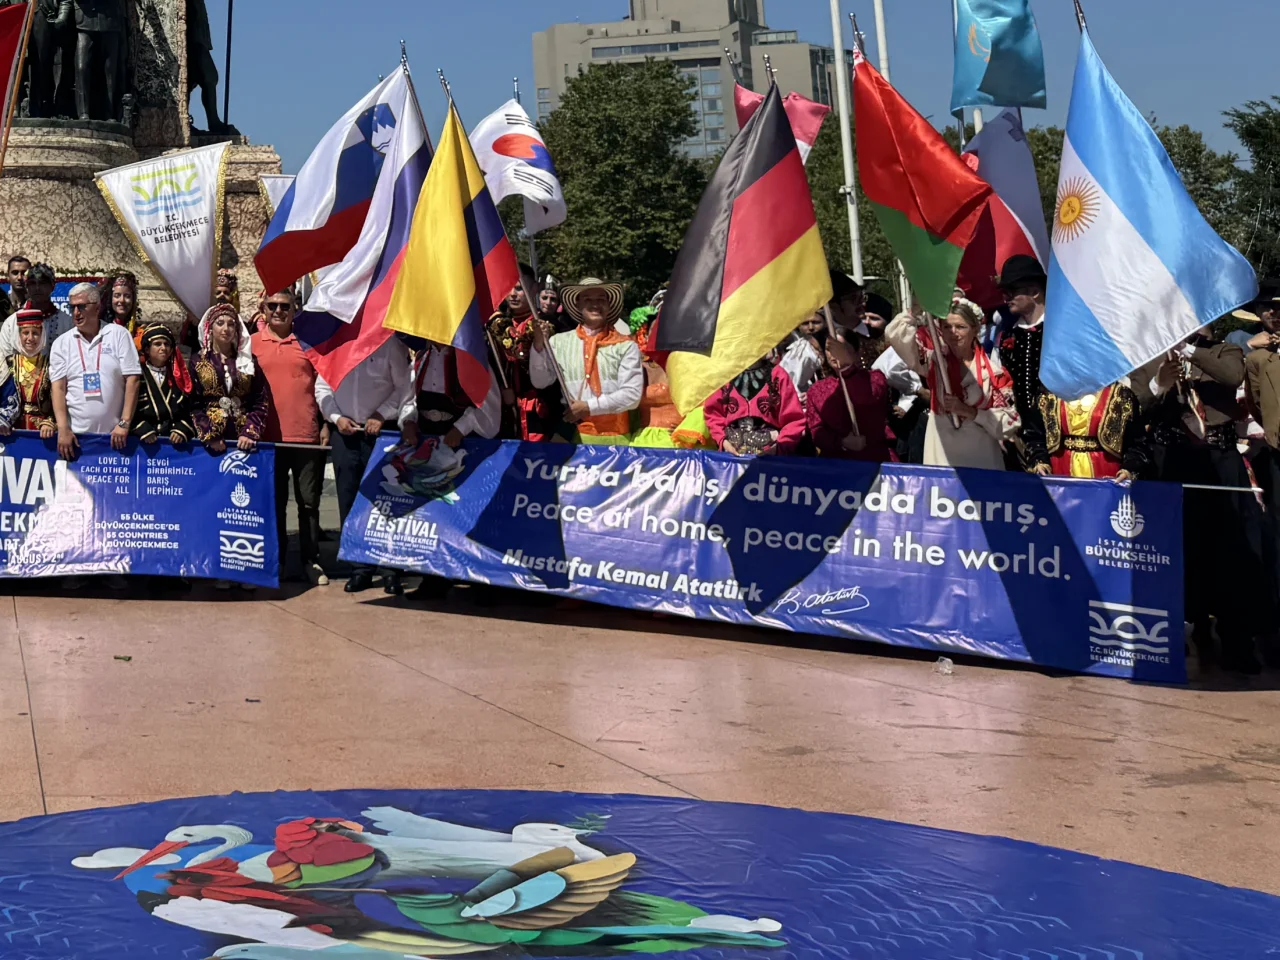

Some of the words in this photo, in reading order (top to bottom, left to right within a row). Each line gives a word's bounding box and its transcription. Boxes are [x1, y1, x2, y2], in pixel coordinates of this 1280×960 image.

[166, 214, 179, 222] T.C.
[140, 216, 209, 237] BÜYÜKÇEKMECE
[154, 227, 200, 244] BELEDİYESİ
[120, 457, 130, 465] TO
[147, 458, 169, 466] SEVGİ
[103, 466, 130, 474] OTHER,
[147, 467, 196, 476] BİRBİRİMİZE,
[231, 467, 258, 478] Türkiye
[147, 476, 170, 486] BARIŞ
[116, 486, 130, 494] ALL
[147, 486, 183, 496] HEPİMİZE
[524, 458, 620, 488] Yurtta
[743, 474, 914, 516] dünyada
[930, 486, 1049, 534] barış.
[371, 501, 393, 515] 26.
[132, 512, 154, 520] ÜLKE
[217, 512, 264, 523] BÜYÜKŞEHİR
[367, 515, 438, 537] FESTİVAL
[512, 494, 594, 524] Peace
[604, 506, 632, 528] at
[641, 510, 730, 548] home,
[743, 526, 841, 554] peace
[853, 529, 880, 558] in
[893, 531, 946, 566] the
[958, 542, 1071, 581] world.
[107, 539, 178, 549] BÜYÜKÇEKMECE
[1098, 537, 1157, 552] İSTANBUL
[1085, 545, 1170, 566] BÜYÜKŞEHİR
[1098, 559, 1158, 572] BELEDİYESİ
[502, 548, 593, 580] Mustafa
[596, 561, 669, 590] Kemal
[672, 574, 764, 602] Atatürk
[1090, 646, 1102, 654] T.C.
[1103, 646, 1170, 664] BÜYÜKÇEKMECE
[1090, 654, 1134, 666] BELEDİYESİ
